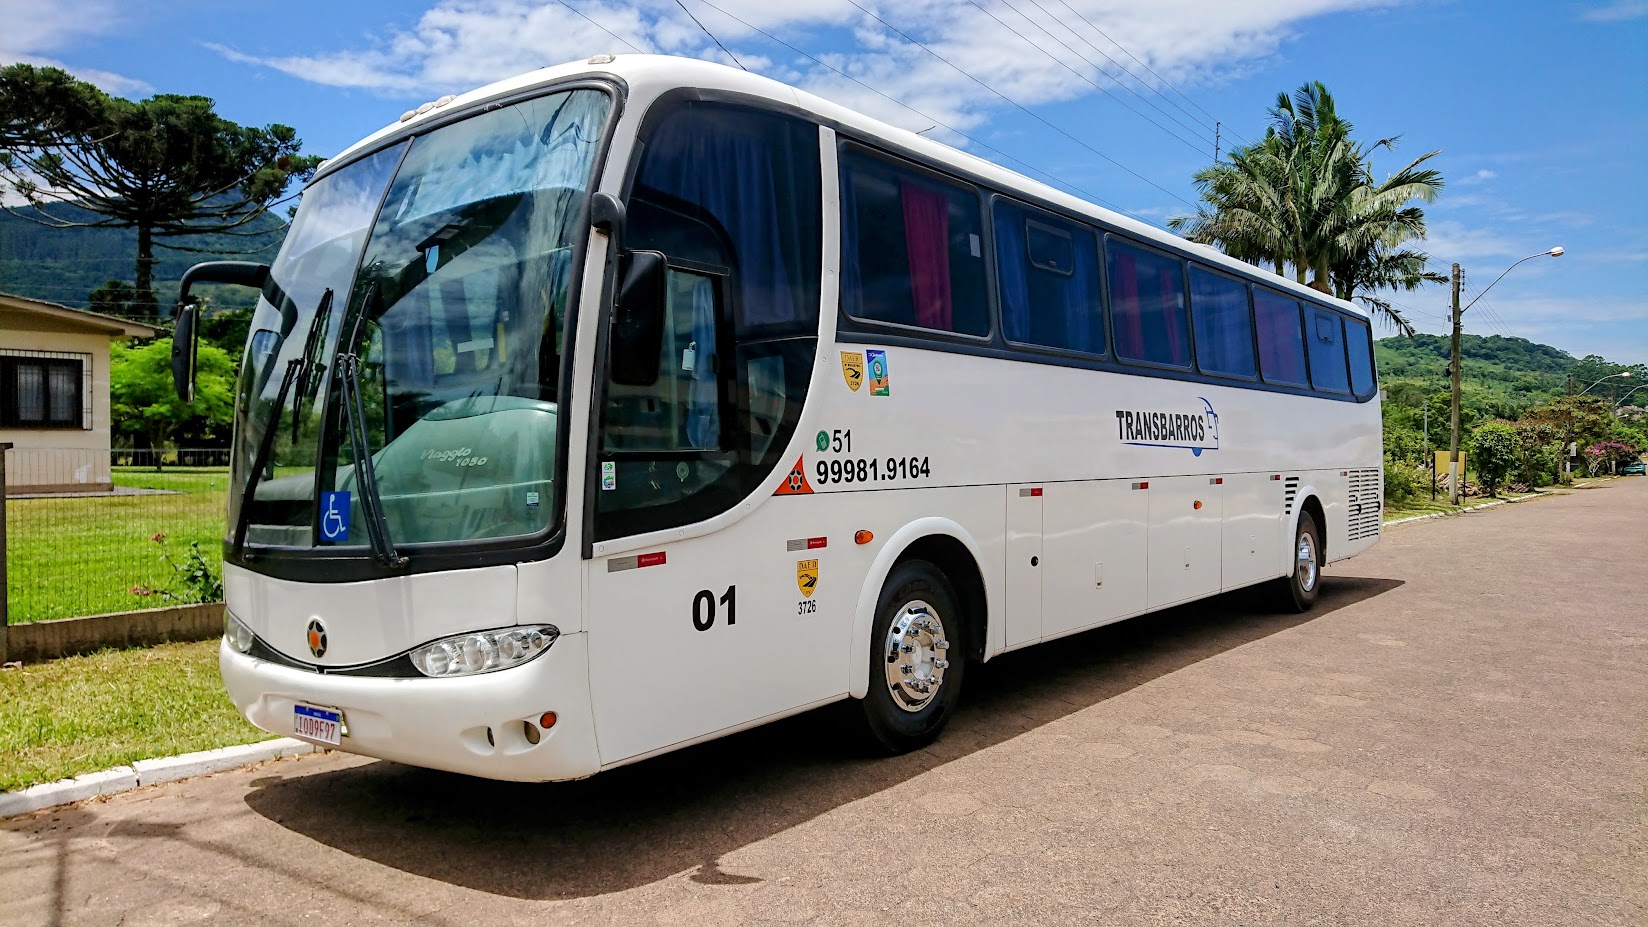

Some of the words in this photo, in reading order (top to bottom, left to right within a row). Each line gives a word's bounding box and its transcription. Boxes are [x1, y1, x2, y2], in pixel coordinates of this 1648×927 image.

[1115, 410, 1205, 442] TRANSBARROS
[832, 429, 852, 453] 51
[420, 447, 472, 462] Viaggio
[455, 456, 488, 467] 1050
[816, 456, 931, 485] 99981.9164
[692, 584, 736, 632] 01
[798, 599, 817, 616] 3726
